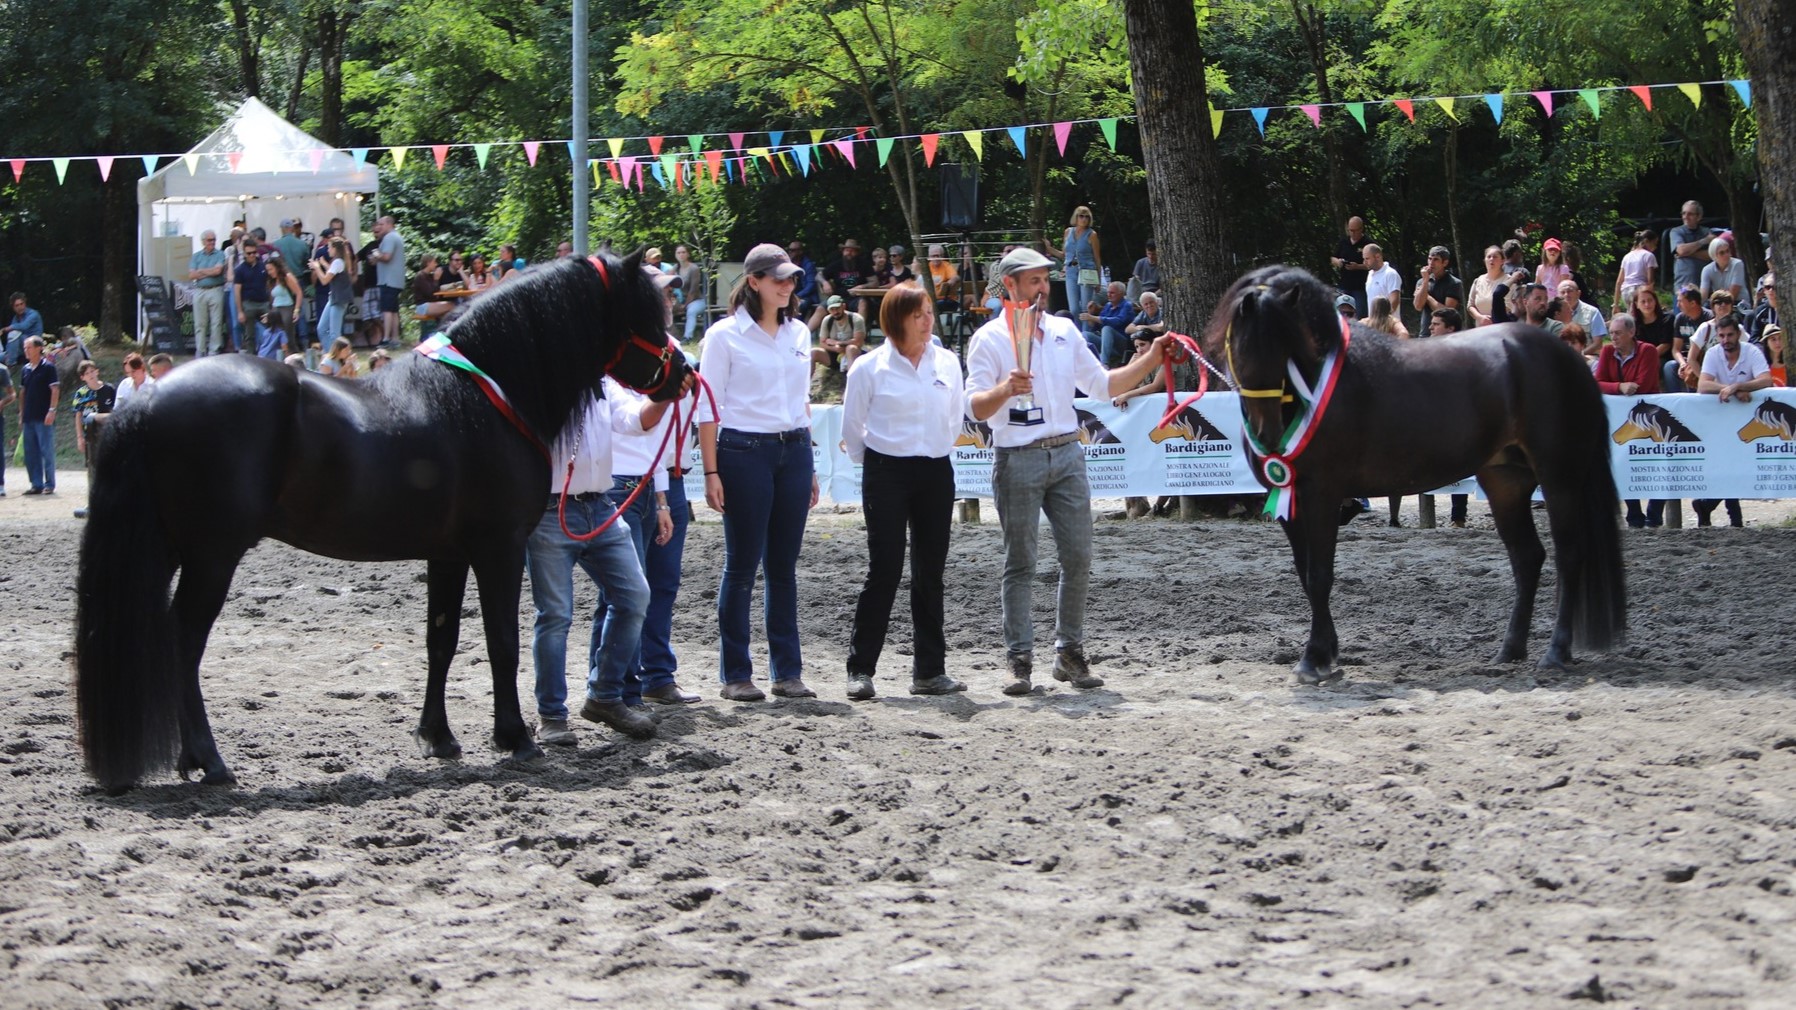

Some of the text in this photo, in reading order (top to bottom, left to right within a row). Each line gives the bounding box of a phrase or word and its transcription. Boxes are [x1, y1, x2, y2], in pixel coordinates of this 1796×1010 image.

[1165, 442, 1232, 454] Bardigiano
[1628, 443, 1705, 457] Bardigiano
[1756, 442, 1796, 455] Bardi
[956, 450, 994, 462] Bardig
[1192, 462, 1230, 470] NAZIONALE
[1757, 464, 1788, 472] MOSTRA
[1184, 471, 1232, 479] GENEALOGICO
[1653, 474, 1705, 482] GENEALOGICO
[1192, 479, 1235, 487] BARDIGIANO
[1660, 484, 1708, 492] BARDIGIANO
